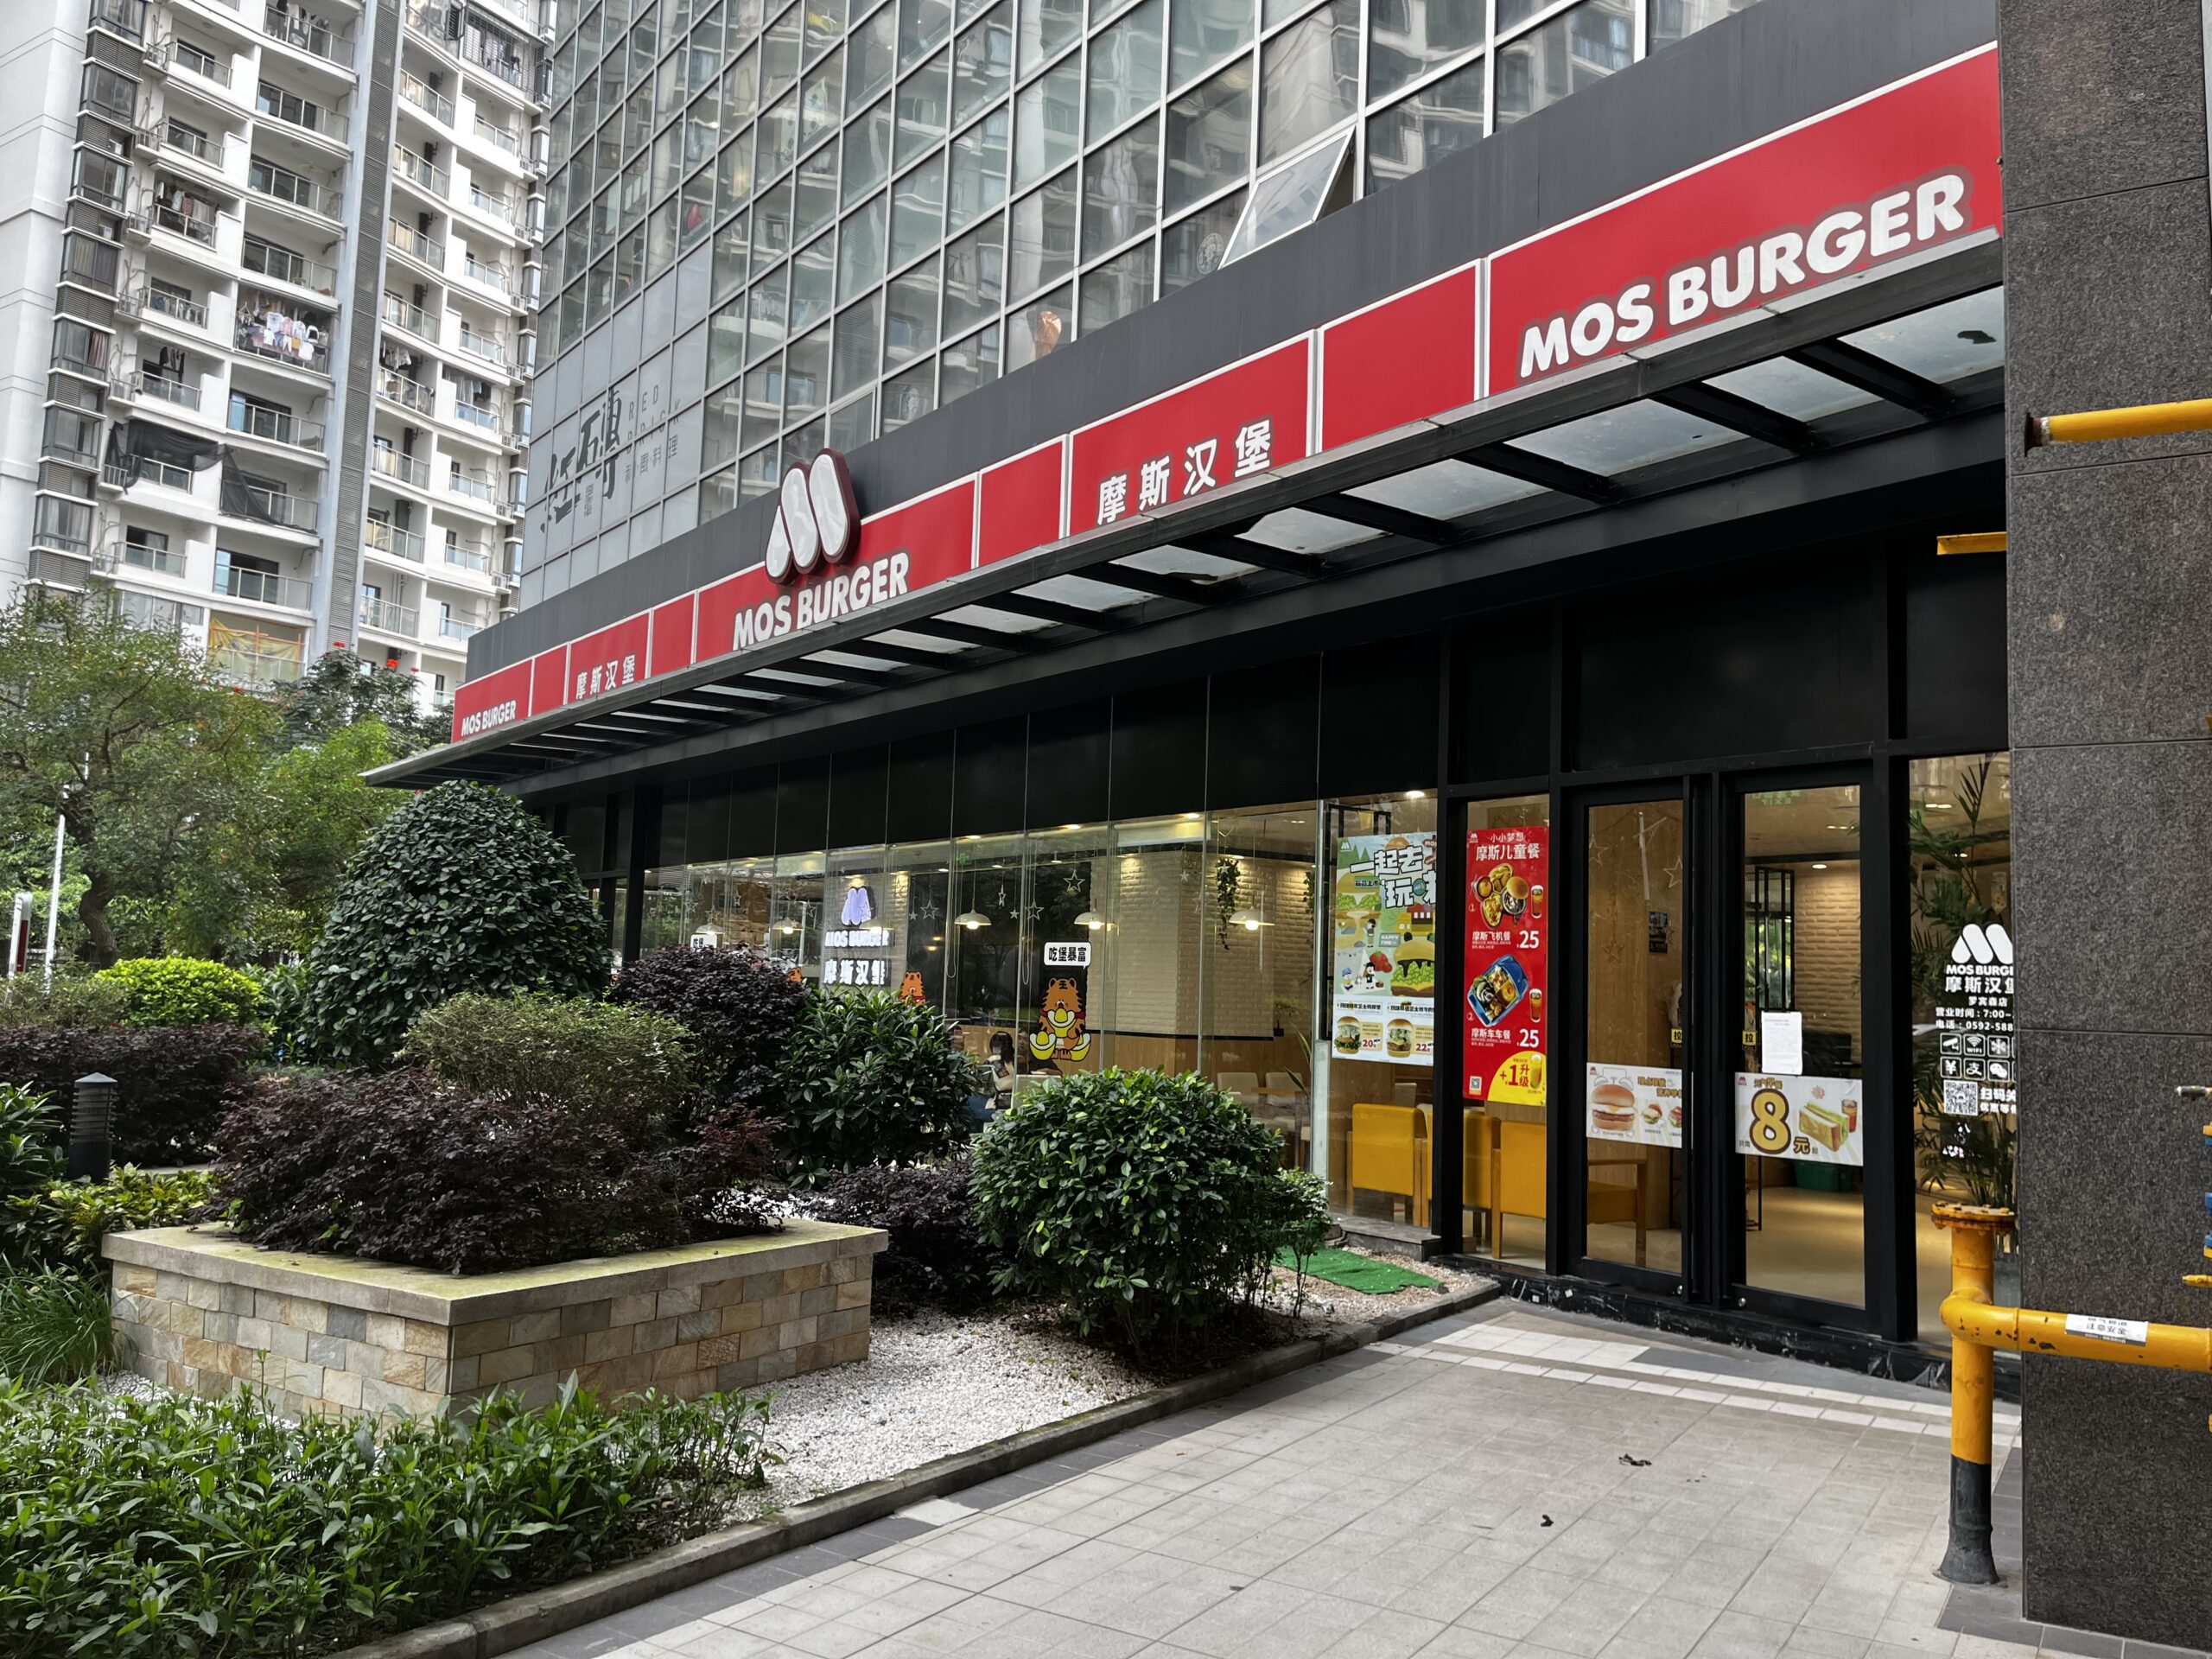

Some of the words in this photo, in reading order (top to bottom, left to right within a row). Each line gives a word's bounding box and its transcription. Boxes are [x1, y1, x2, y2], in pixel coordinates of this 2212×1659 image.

[1520, 283, 1654, 378] MOS
[1669, 174, 1965, 326] BURGER
[628, 385, 658, 422] RED
[1096, 419, 1271, 526] 摩斯汉堡
[733, 595, 791, 651] MOS
[797, 552, 909, 630] BURGER
[575, 654, 635, 700] 摩斯汉堡
[461, 714, 481, 737] MOS
[482, 700, 516, 730] BURGER
[1491, 832, 1524, 843] 小小梦想
[1350, 846, 1423, 876] 一起去
[1476, 843, 1540, 861] 摩斯儿童餐
[1472, 931, 1511, 941] 摩斯飞机餐
[1048, 947, 1087, 962] 吃堡暴富
[823, 959, 886, 985] 摩斯汉堡
[1946, 964, 1974, 975] MOS
[1968, 996, 2007, 1007] 罗宾森店
[1471, 1028, 1510, 1039] 摩斯车车餐
[1674, 1031, 1682, 1040] 拉
[1745, 1033, 1754, 1042] 拉
[1520, 1064, 1529, 1088] 升级
[1750, 1089, 1791, 1155] 8
[1793, 1136, 1810, 1154] 元
